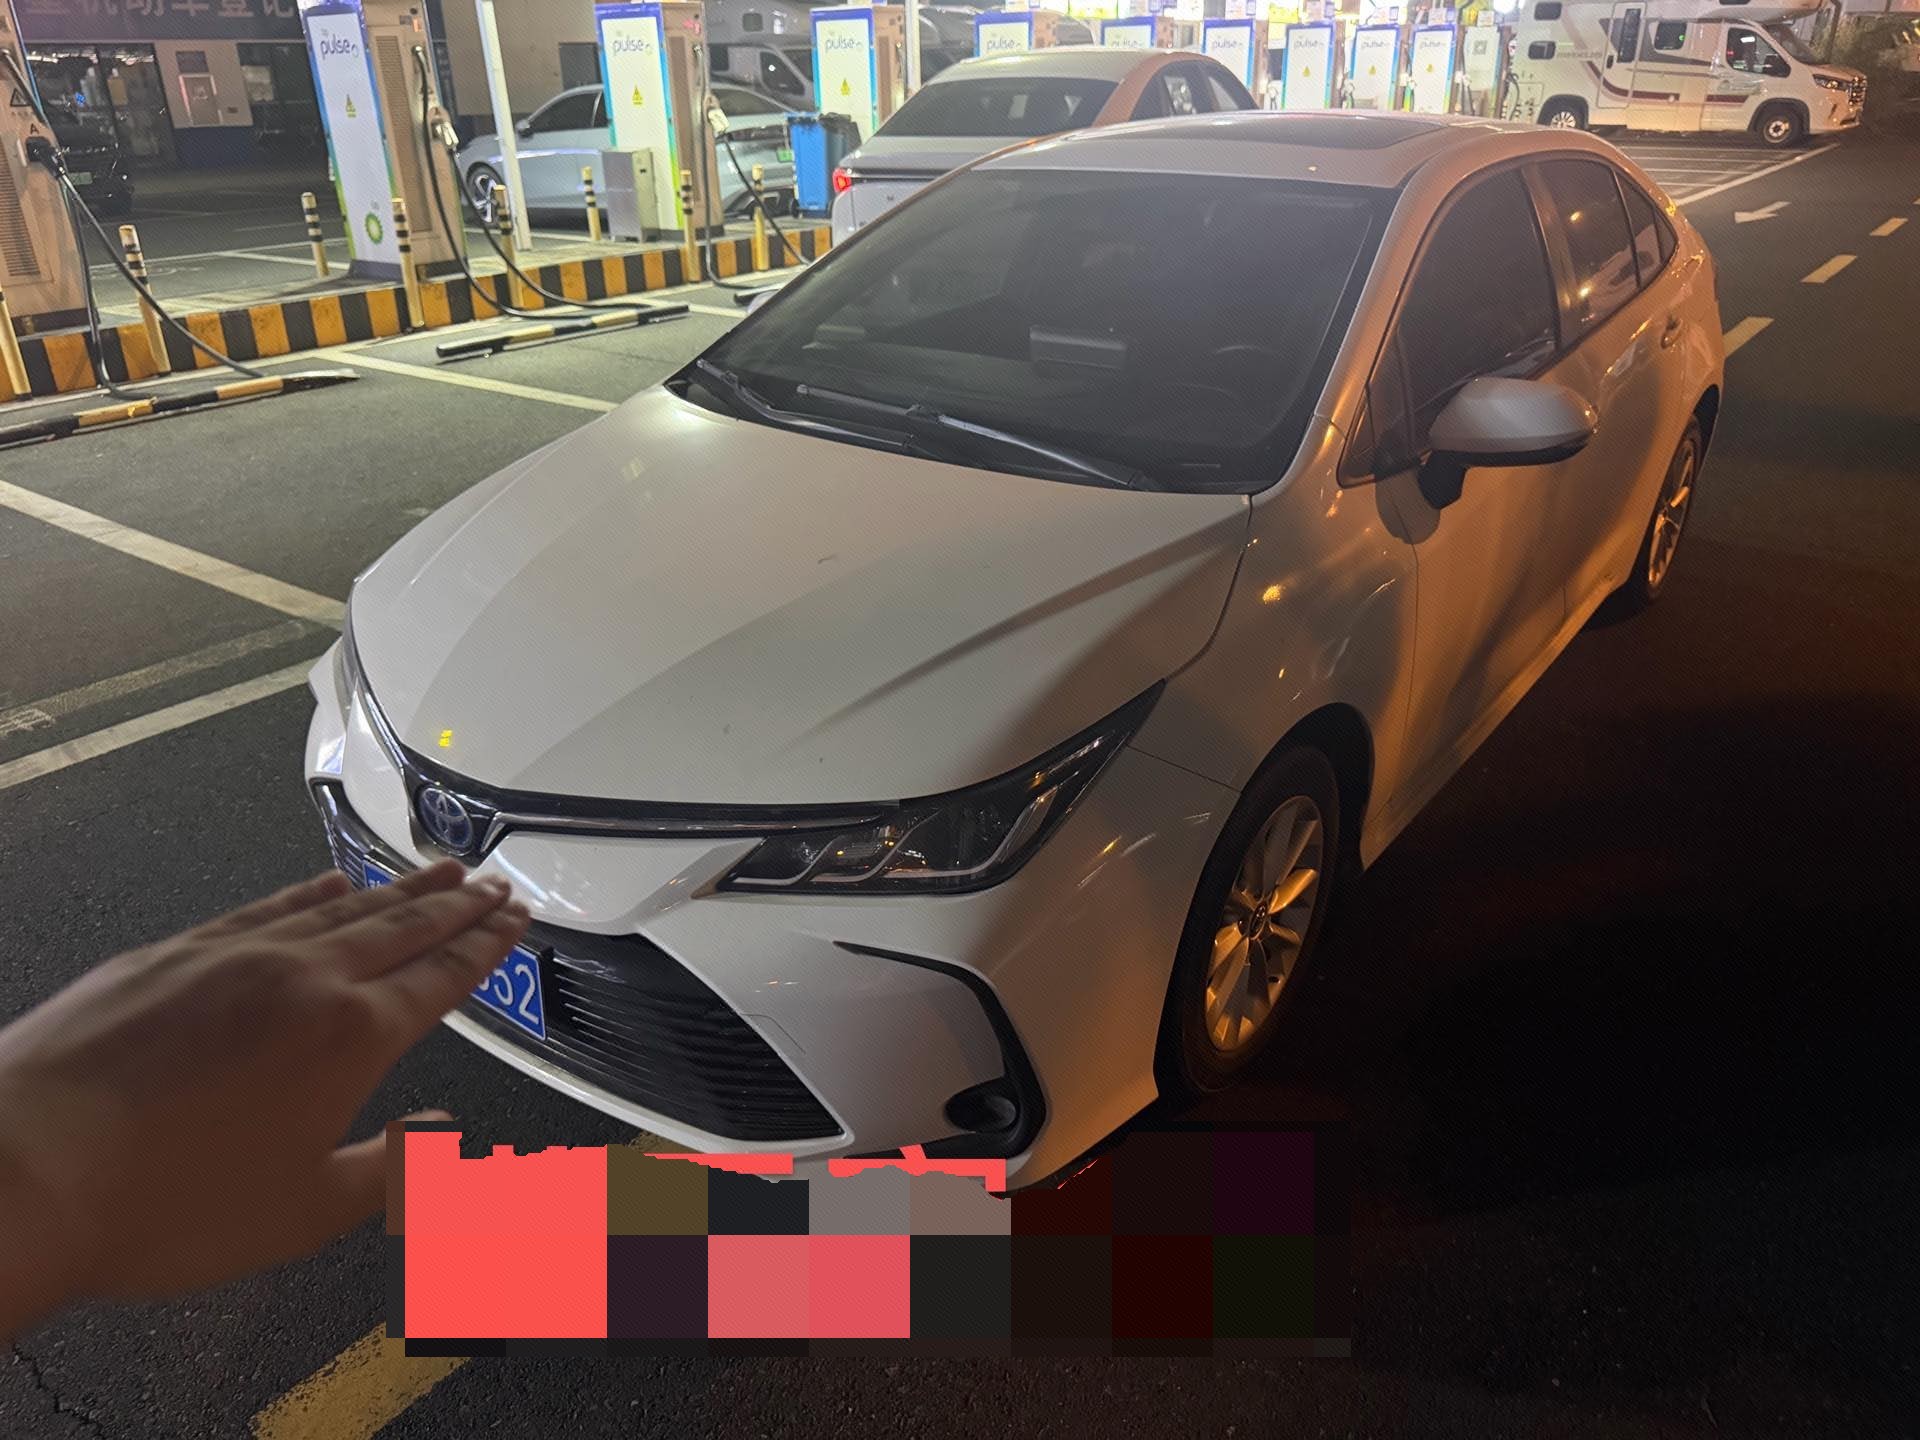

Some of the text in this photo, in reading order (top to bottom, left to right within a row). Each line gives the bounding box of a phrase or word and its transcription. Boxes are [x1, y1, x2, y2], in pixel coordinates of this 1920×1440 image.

[320, 34, 350, 60] pulse
[612, 35, 644, 56] pulse
[825, 35, 854, 53] pulse
